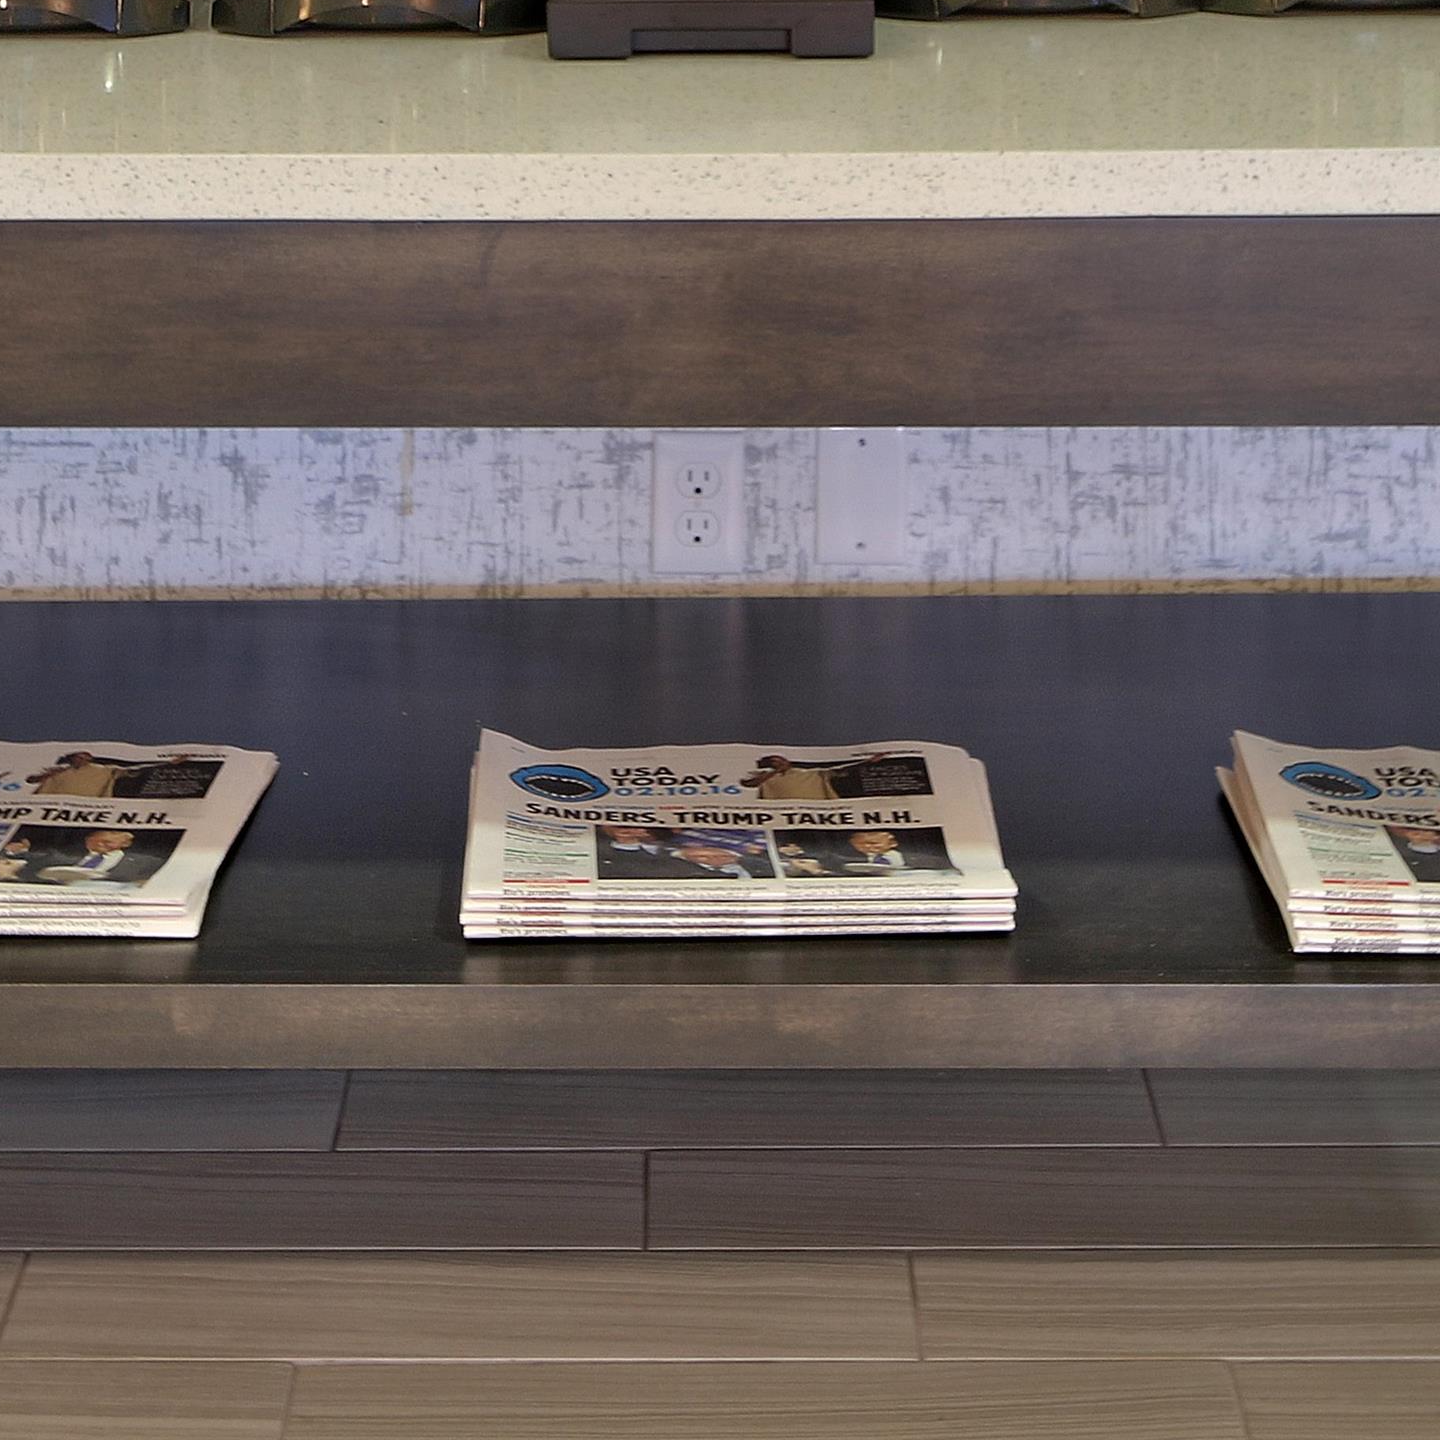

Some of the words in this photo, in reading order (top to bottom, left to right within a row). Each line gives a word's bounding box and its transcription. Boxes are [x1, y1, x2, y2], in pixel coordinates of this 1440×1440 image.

[611, 766, 675, 777] USA
[1374, 766, 1438, 778] USA
[611, 774, 721, 786] TODAY
[614, 785, 743, 797] 02.10.16
[39, 807, 114, 823] TAKE
[116, 812, 173, 825] N.H.
[673, 811, 774, 826] TRUMP
[780, 812, 855, 825] TAKE
[862, 810, 921, 825] N.H.
